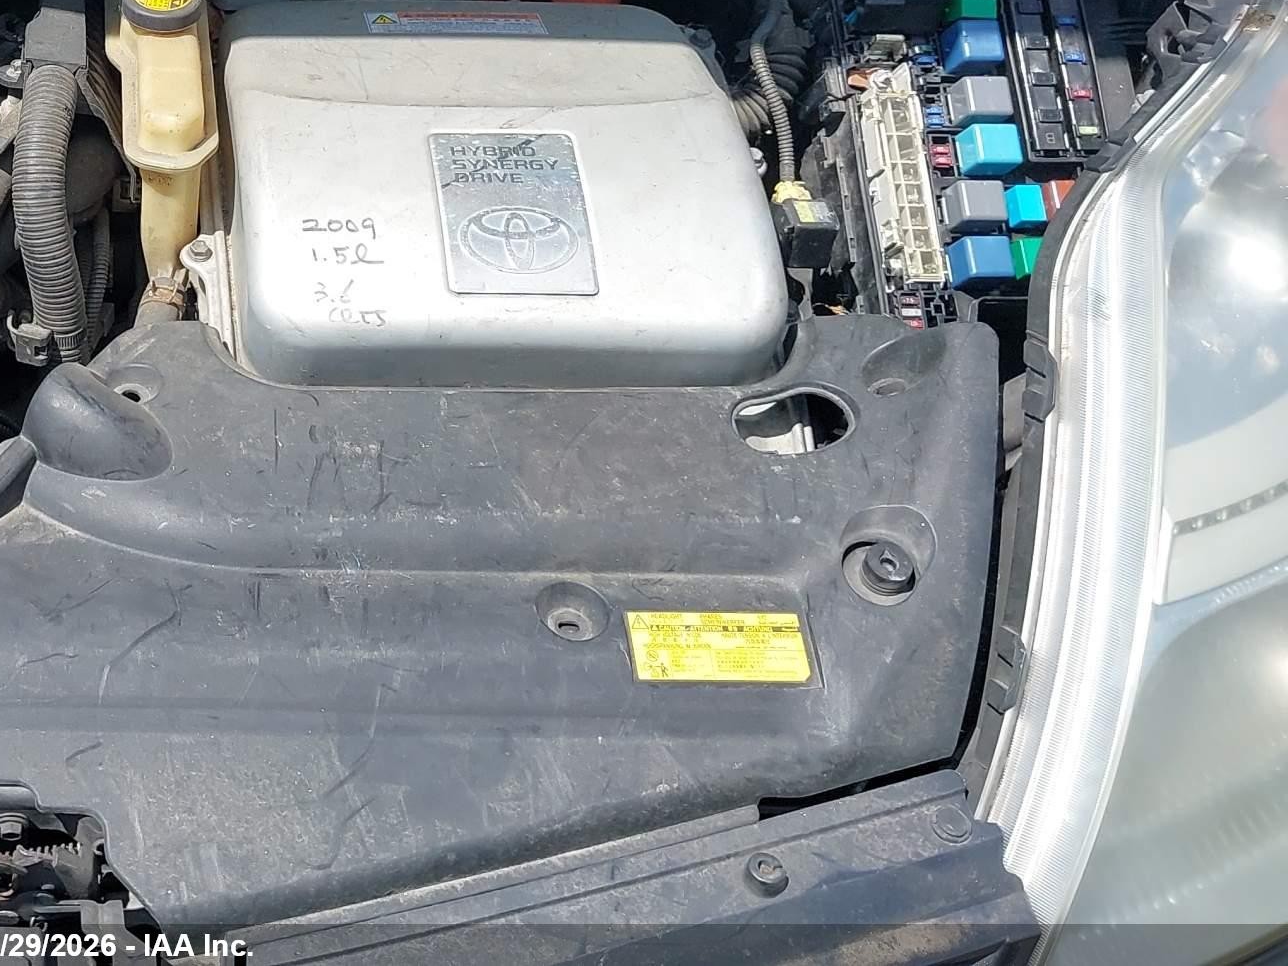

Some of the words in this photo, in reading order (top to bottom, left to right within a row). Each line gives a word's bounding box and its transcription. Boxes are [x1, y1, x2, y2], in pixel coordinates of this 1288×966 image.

[450, 145, 537, 157] HYBRID
[451, 158, 559, 171] SYNERGY
[454, 172, 524, 184] DRIVE
[301, 217, 376, 240] 2009
